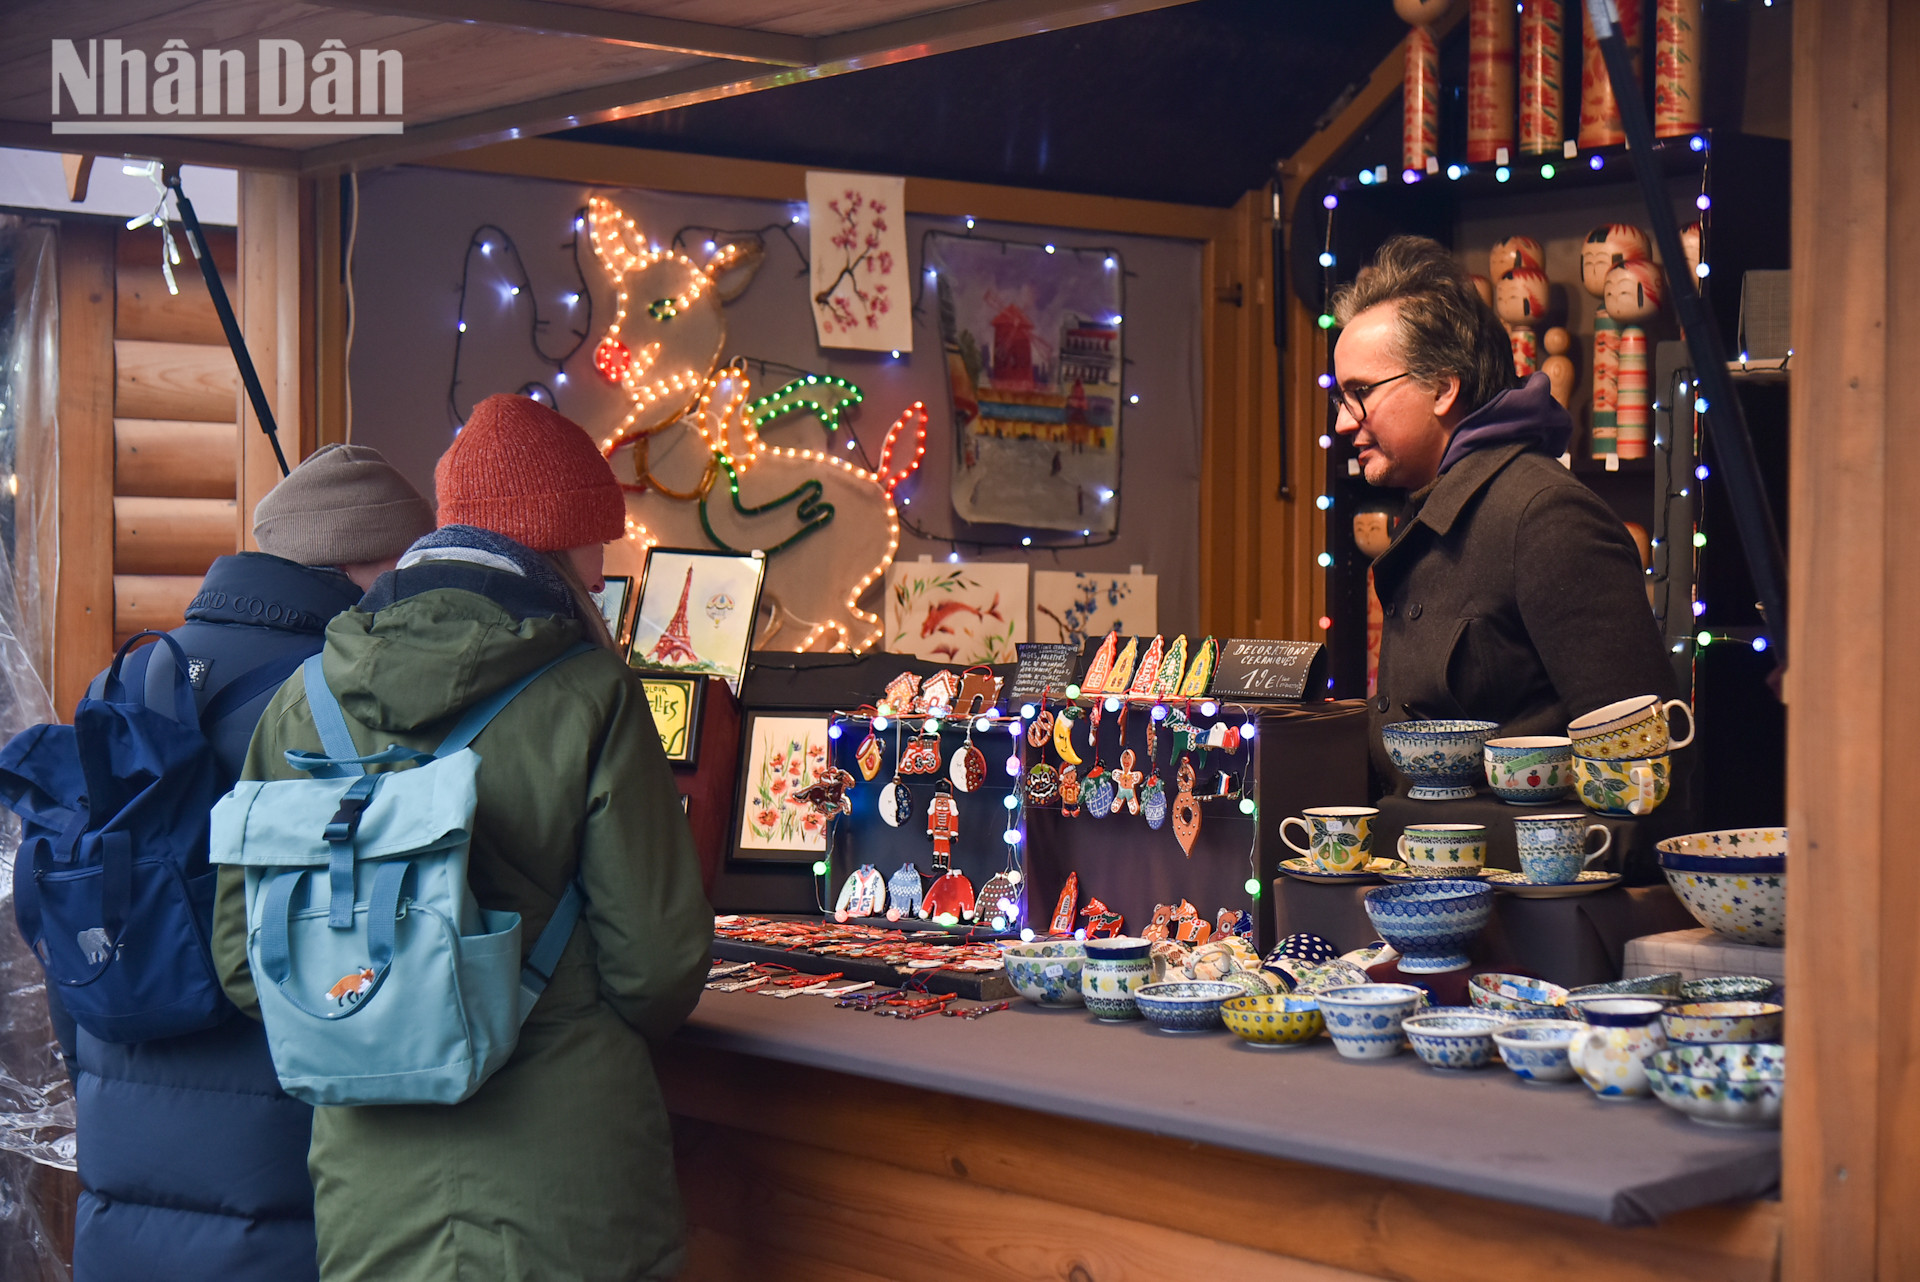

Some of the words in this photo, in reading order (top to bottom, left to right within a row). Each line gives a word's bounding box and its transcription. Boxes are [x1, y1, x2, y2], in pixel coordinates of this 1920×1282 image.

[1240, 655, 1297, 666] CERAMIQUES
[1240, 668, 1277, 689] 19€
[644, 686, 668, 695] OLOUR
